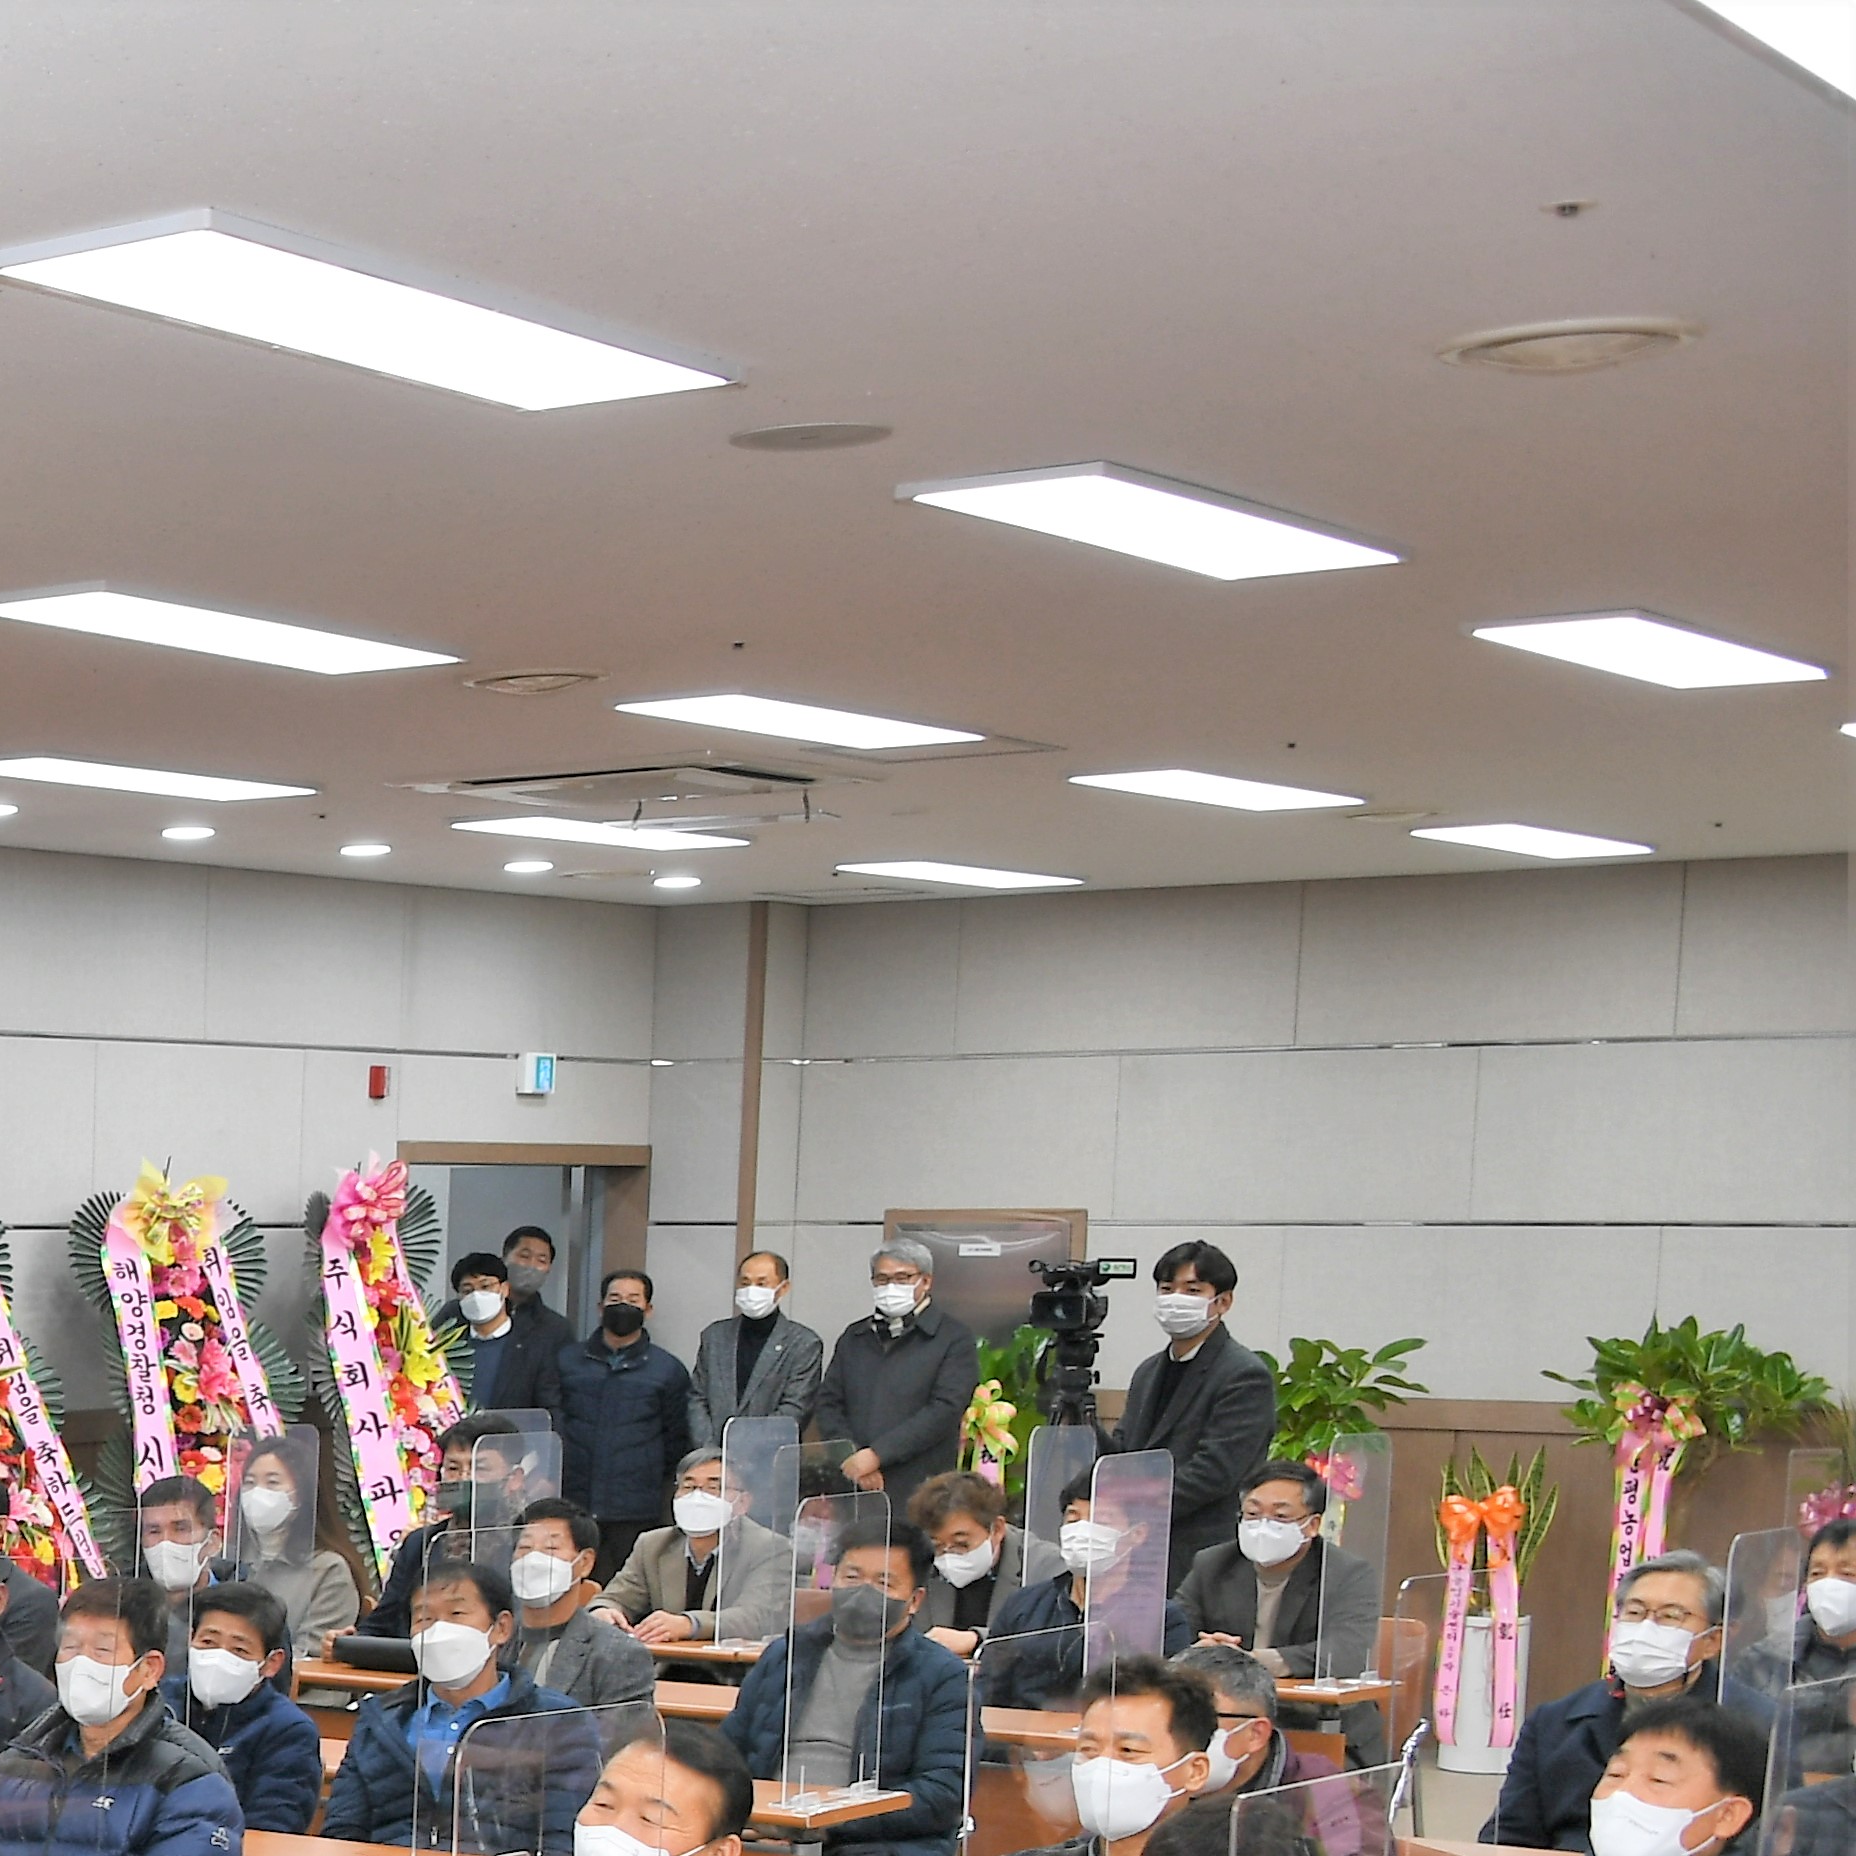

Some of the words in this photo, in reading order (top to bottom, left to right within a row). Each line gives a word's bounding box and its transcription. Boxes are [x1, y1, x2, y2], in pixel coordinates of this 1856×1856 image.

[112, 1257, 156, 1415] 해양경찰청
[202, 1246, 249, 1361] 취임을
[324, 1258, 389, 1441] 주식회사
